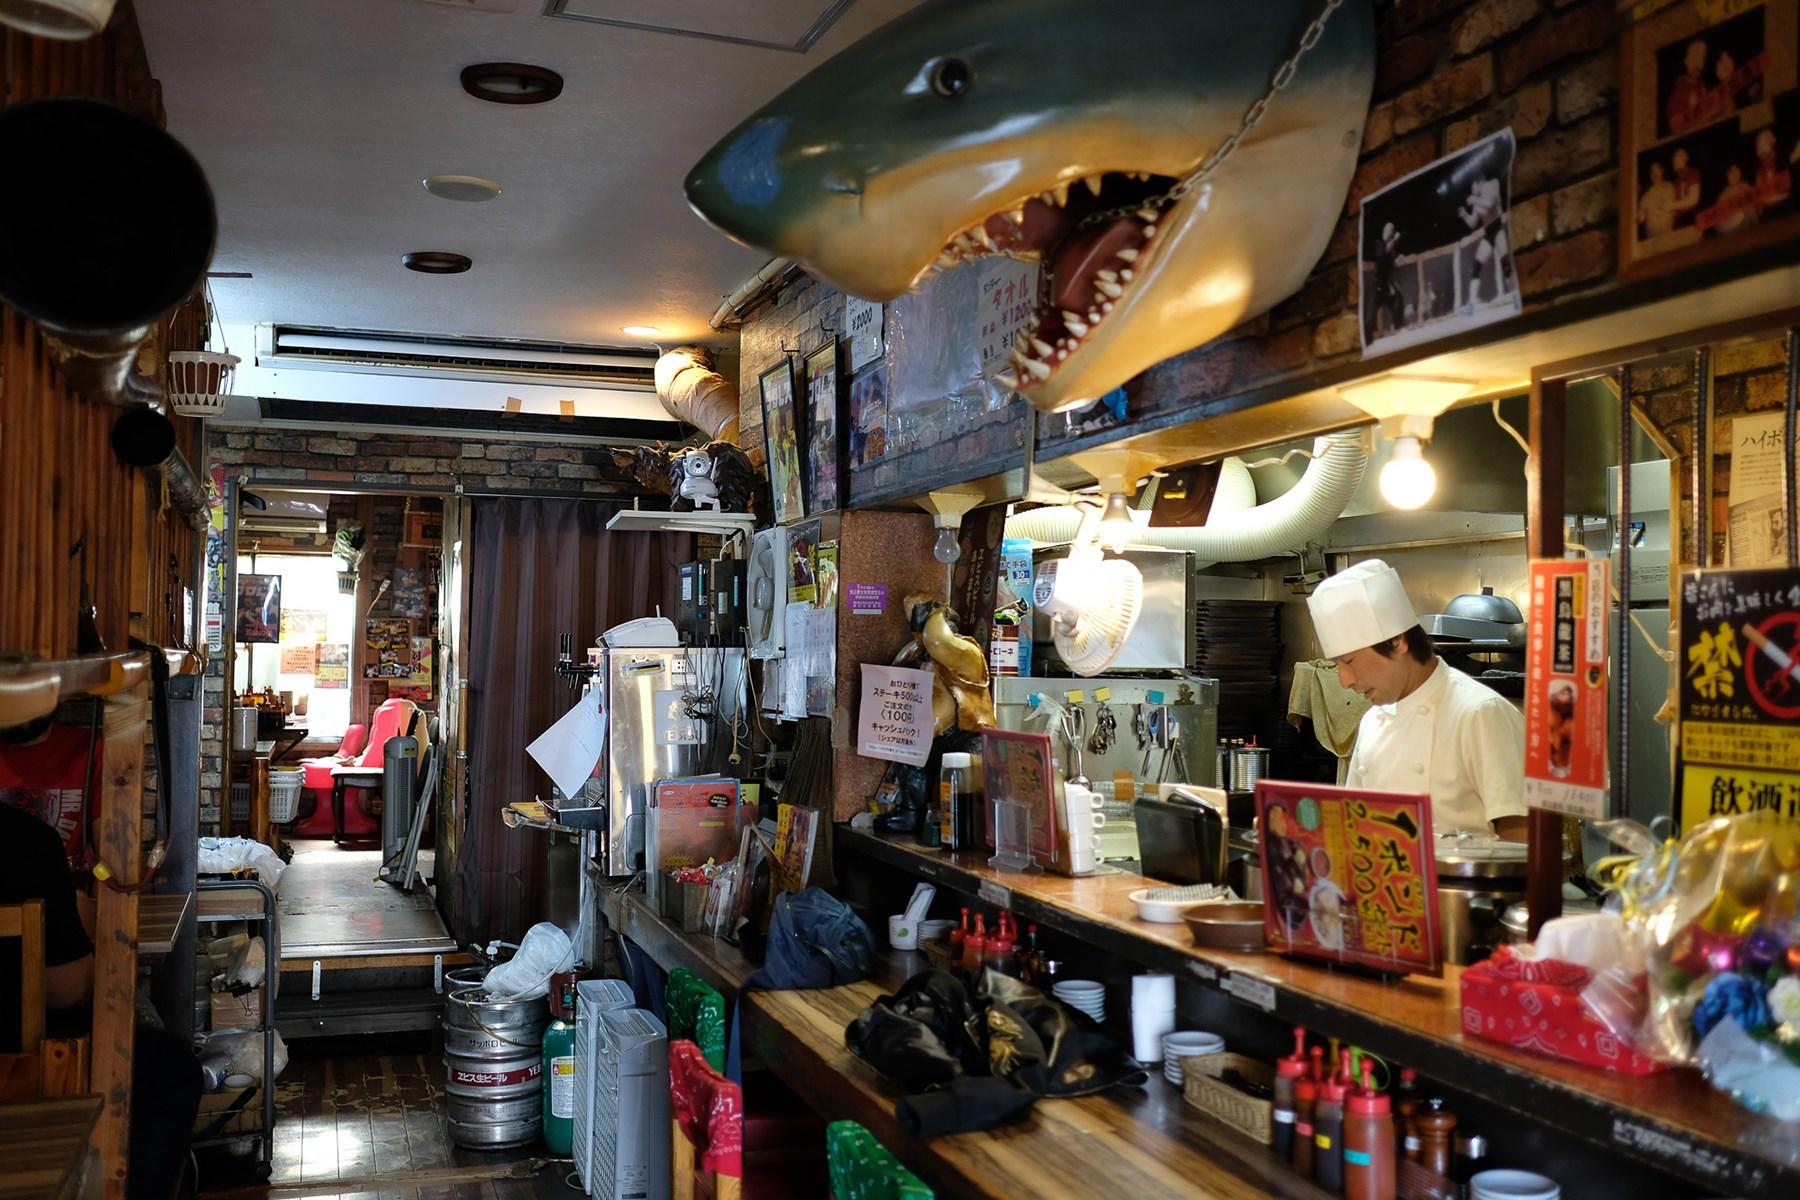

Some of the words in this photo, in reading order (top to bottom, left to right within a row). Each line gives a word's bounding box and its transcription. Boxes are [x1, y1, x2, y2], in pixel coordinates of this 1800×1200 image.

[993, 274, 1030, 310] タオル
[990, 648, 1014, 657] ローネ
[1687, 621, 1743, 699] 禁
